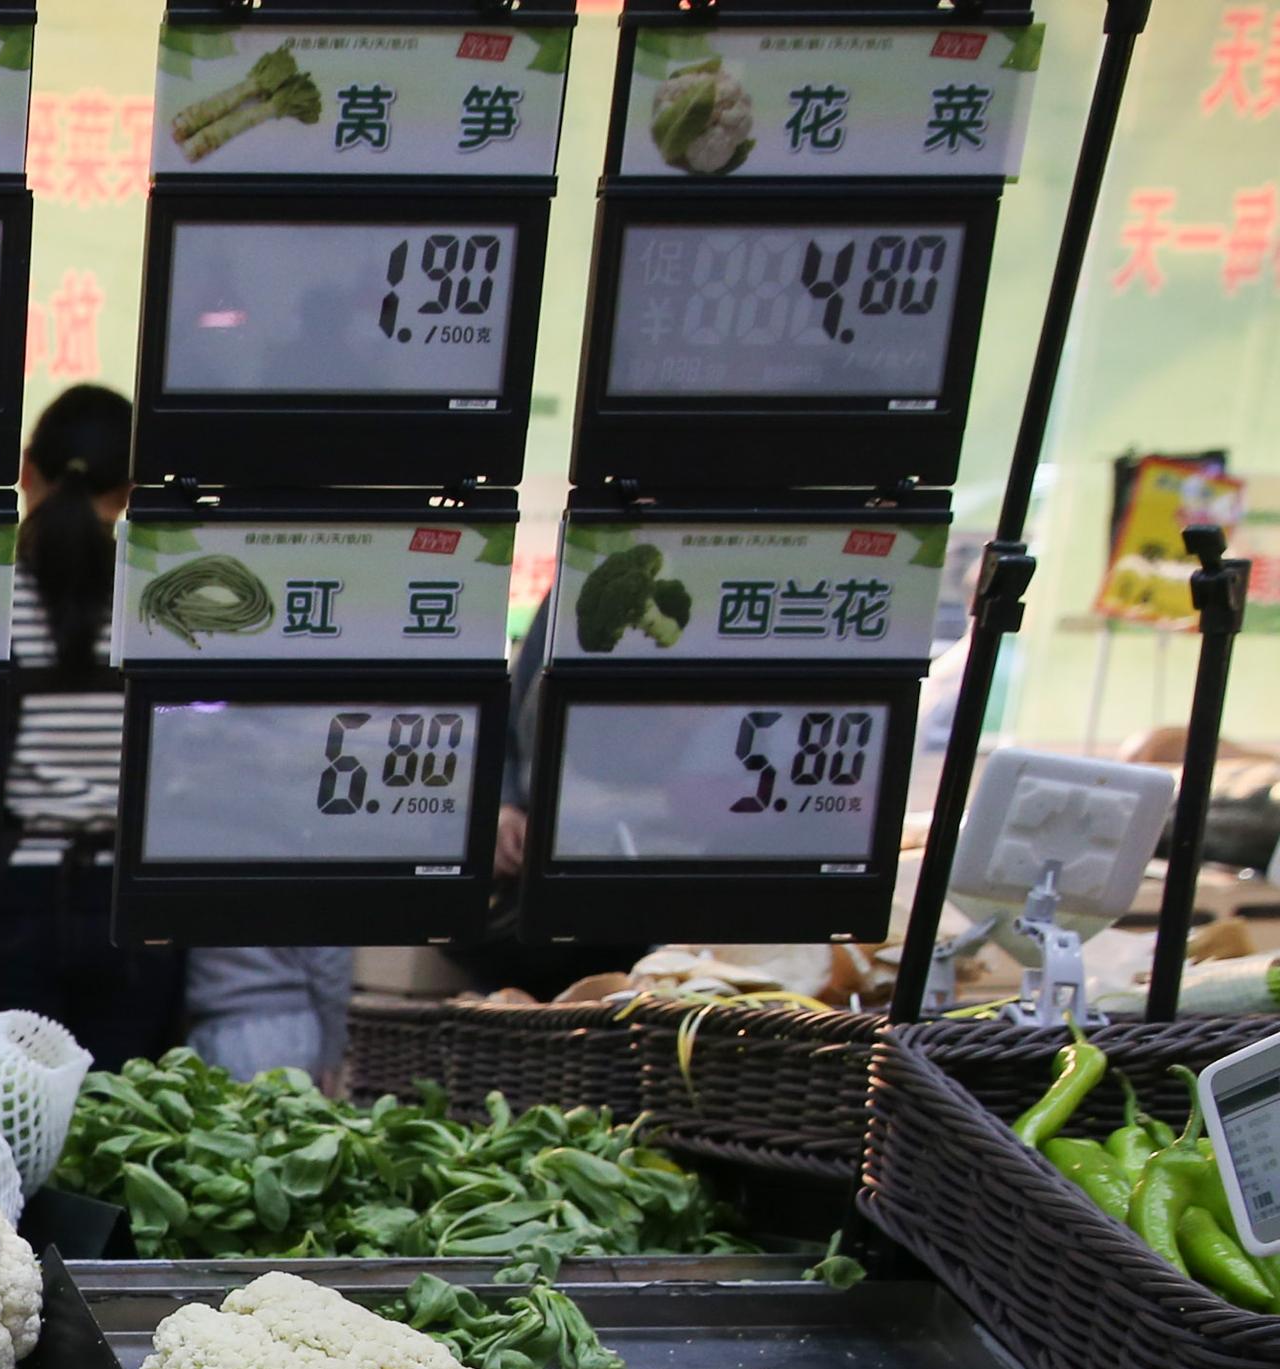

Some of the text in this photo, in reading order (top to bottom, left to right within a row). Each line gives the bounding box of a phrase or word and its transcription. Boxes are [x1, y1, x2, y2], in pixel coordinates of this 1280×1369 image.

[334, 83, 518, 149] 莴笋
[784, 83, 991, 149] 花菜
[378, 234, 501, 343] 1.90
[800, 235, 947, 344] 4.80
[424, 325, 493, 344] /500克
[282, 580, 460, 634] 豇豆
[717, 578, 890, 637] 西兰花
[316, 712, 464, 815] 6.80
[728, 711, 874, 814] 5.80
[391, 796, 456, 815] /500克
[797, 795, 863, 813] /500克
